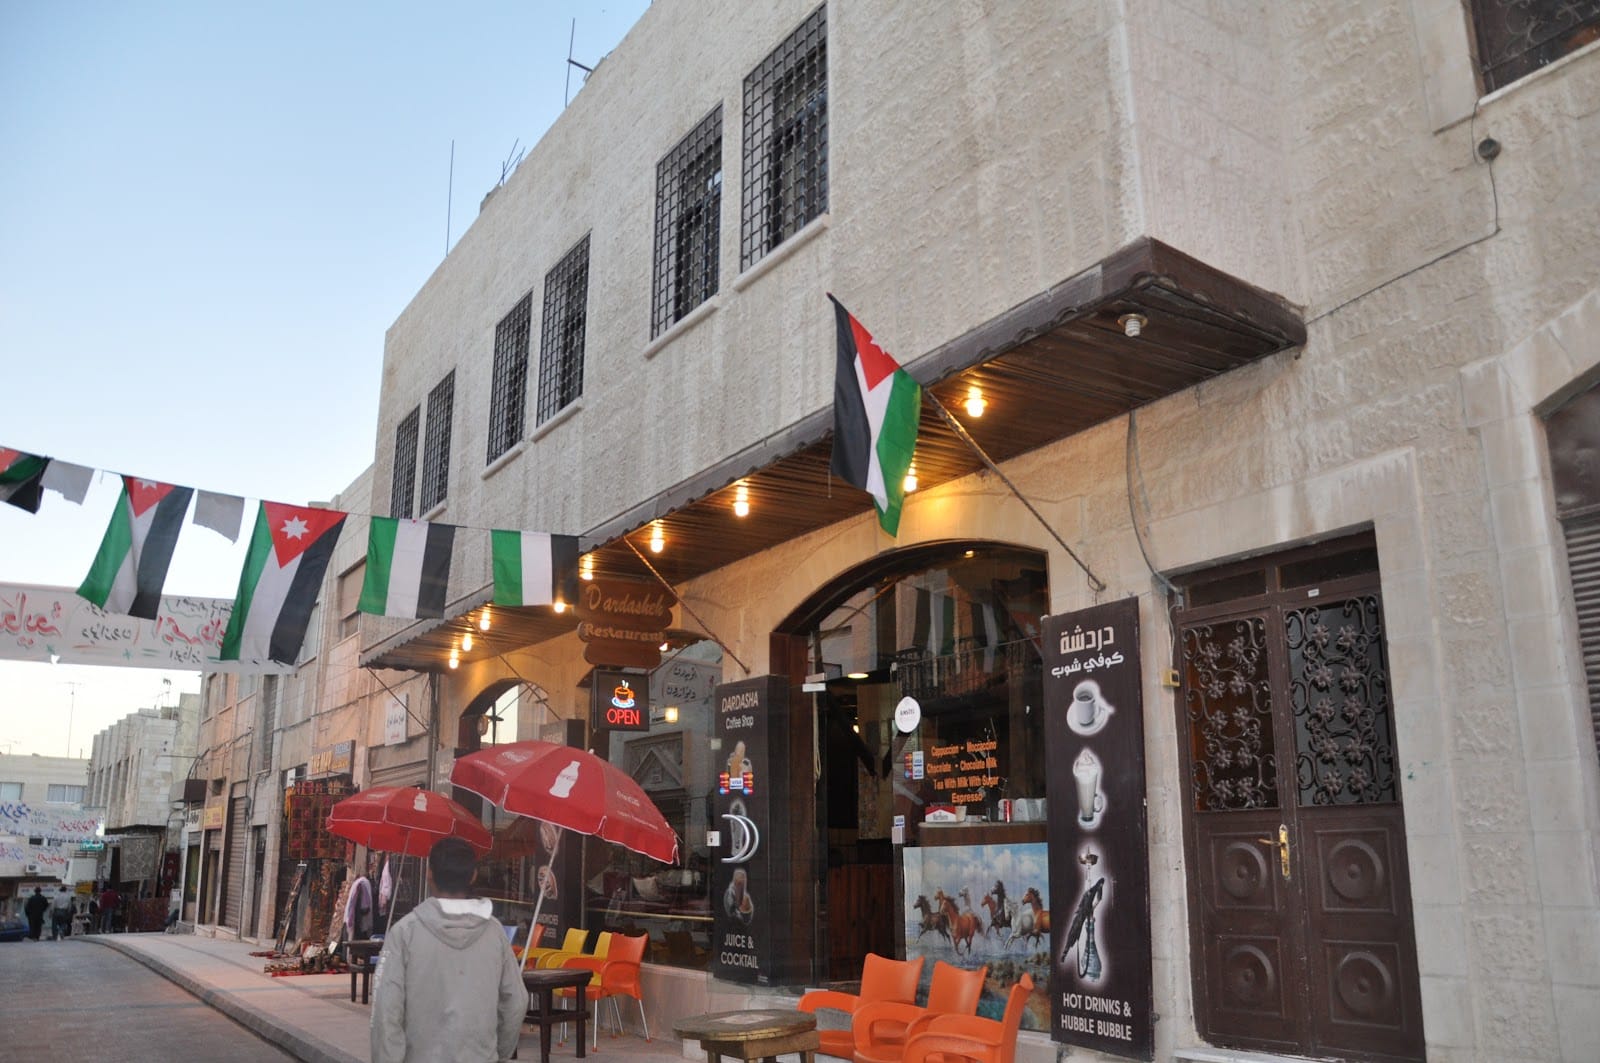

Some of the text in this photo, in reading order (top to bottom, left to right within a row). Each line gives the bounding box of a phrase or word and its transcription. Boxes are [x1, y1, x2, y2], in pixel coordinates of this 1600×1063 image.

[584, 623, 665, 642] Restaurant
[1060, 625, 1114, 654] دردشة
[1051, 651, 1124, 678] كوفي شوب
[721, 691, 759, 713] DARDASHA
[606, 708, 640, 726] OPEN
[726, 715, 754, 730] Coffee Shop
[981, 774, 999, 788] Sugar
[951, 792, 983, 804] Espresso
[724, 934, 754, 949] JUICE &
[720, 951, 759, 969] COCKTAIL
[1062, 992, 1132, 1017] HOT DRINKS &
[1061, 1014, 1132, 1041] HUBBLE BUBBLE
